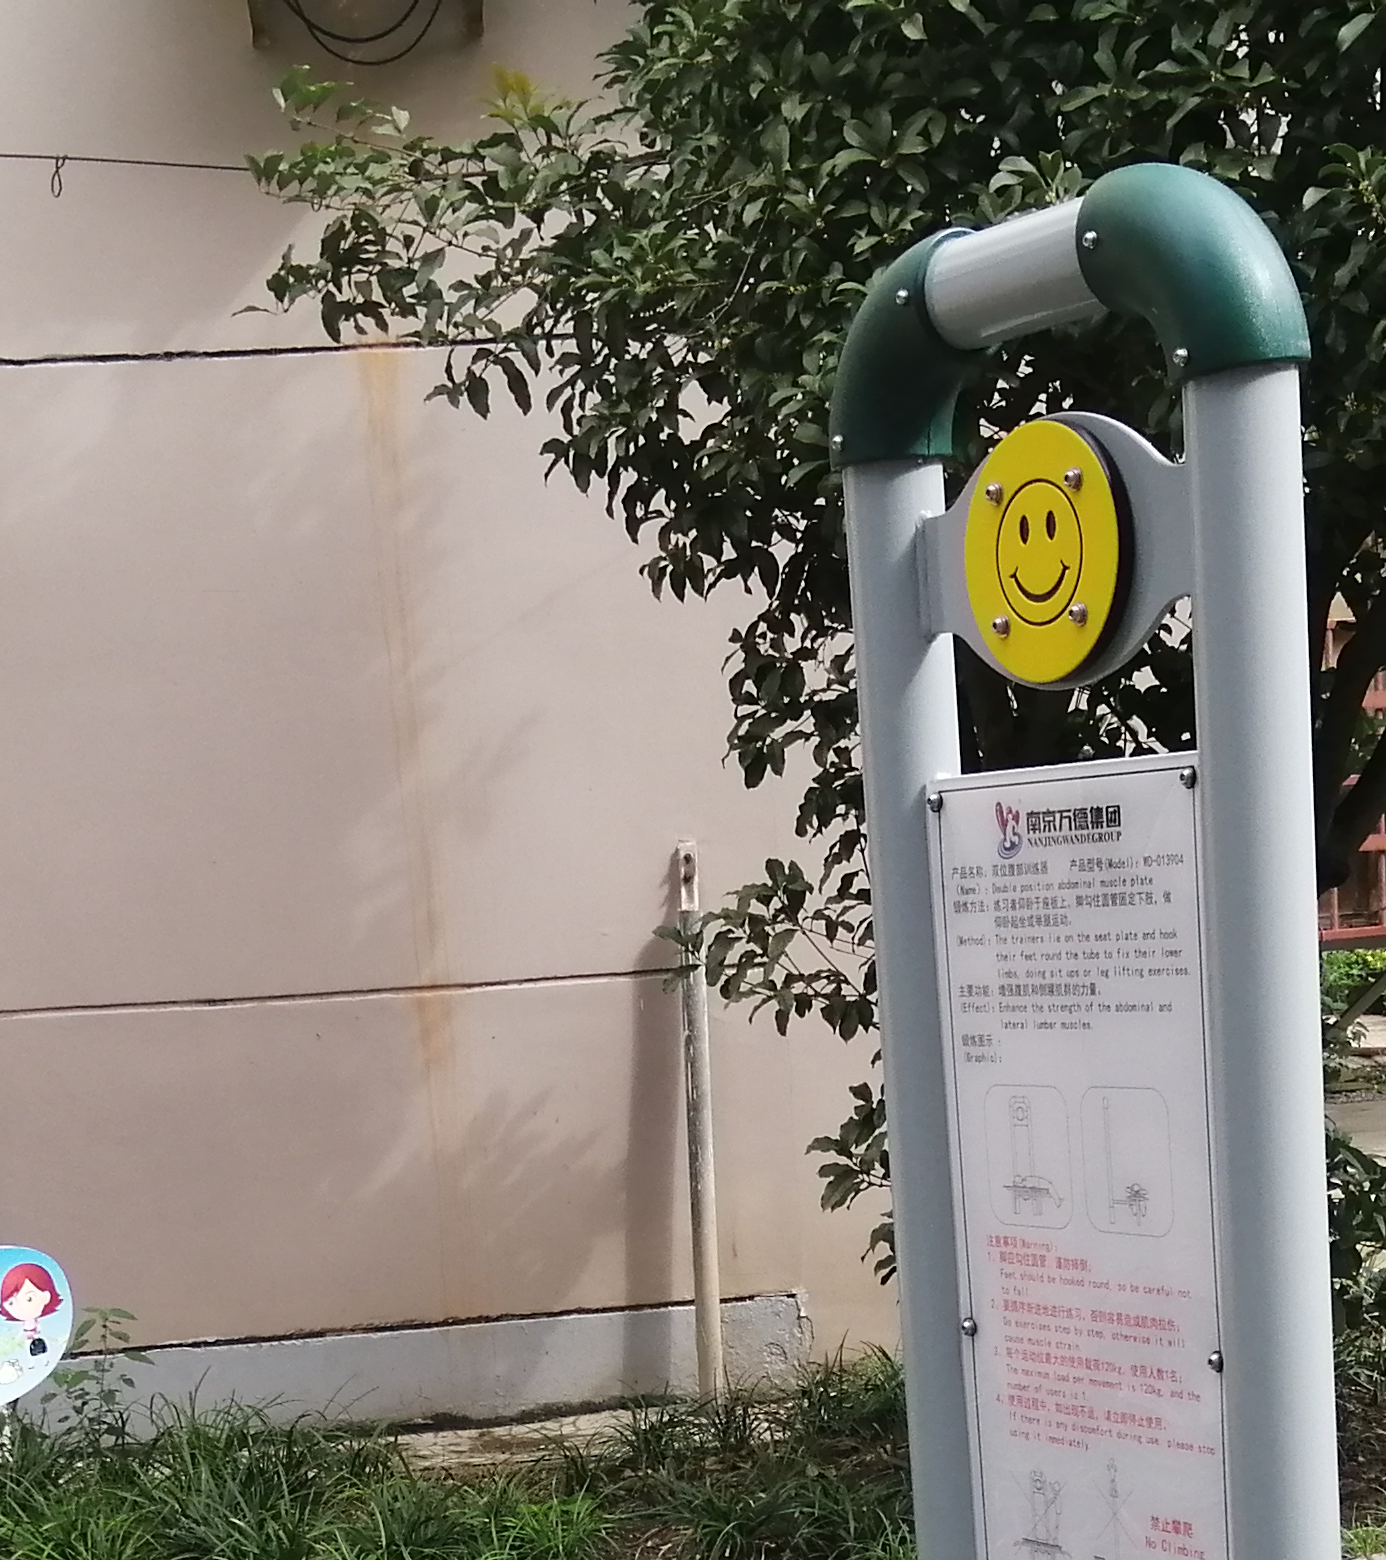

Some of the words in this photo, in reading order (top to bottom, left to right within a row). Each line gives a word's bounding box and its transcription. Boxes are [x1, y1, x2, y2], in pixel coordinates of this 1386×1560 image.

[1026, 805, 1121, 834] 南京万德集团
[992, 882, 1017, 894] Double
[1020, 882, 1053, 894] position
[1058, 878, 1095, 890] abdominal
[1099, 876, 1127, 888] muscle
[1130, 875, 1153, 888] plate
[995, 934, 1008, 945] The
[1011, 934, 1044, 945] trainers
[1049, 932, 1061, 943] lie
[1064, 934, 1073, 943] on
[1077, 932, 1091, 943] the
[1094, 932, 1111, 942] seat
[1115, 930, 1138, 942] plate
[1142, 929, 1156, 940] and
[1159, 928, 1178, 940] hook
[996, 952, 1016, 962] their
[1020, 950, 1037, 961] feet
[1040, 950, 1062, 961] round
[1065, 950, 1079, 961] the
[1082, 949, 1100, 960] tube
[1104, 949, 1113, 959] to
[1116, 947, 1130, 959] fix
[1134, 947, 1156, 959] their
[1161, 947, 1183, 958] lower
[1025, 968, 1046, 980] doing
[1050, 968, 1062, 979] sit
[1083, 969, 1092, 978] or
[1096, 967, 1109, 979] leg
[1114, 965, 1145, 979] lifting
[998, 1002, 1028, 1013] Enhance
[1031, 1002, 1044, 1013] the
[1047, 1002, 1082, 1014] strength
[1085, 1001, 1094, 1013] of
[1098, 1002, 1111, 1013] the
[1115, 1001, 1154, 1013] abdominal
[1158, 1001, 1173, 1012] and
[1001, 1019, 1028, 1030] lateral
[1001, 1286, 1010, 1295] to
[1020, 1271, 1044, 1283] should
[1047, 1274, 1056, 1284] be
[1059, 1274, 1085, 1287] hooked
[1117, 1283, 1126, 1292] so
[1129, 1282, 1139, 1293] be
[1143, 1285, 1173, 1297] careful
[1054, 1325, 1071, 1335] step
[1111, 1331, 1151, 1345] otherwise
[1155, 1335, 1164, 1347] it
[1168, 1337, 1185, 1349] will
[1034, 1384, 1042, 1393] of
[1170, 1390, 1183, 1400] and
[1187, 1390, 1201, 1402] the
[1116, 1430, 1143, 1444] during
[1167, 1439, 1194, 1452] please
[1198, 1445, 1215, 1456] stop
[1151, 1514, 1194, 1539] 禁止攀爬
[1145, 1535, 1157, 1550] No
